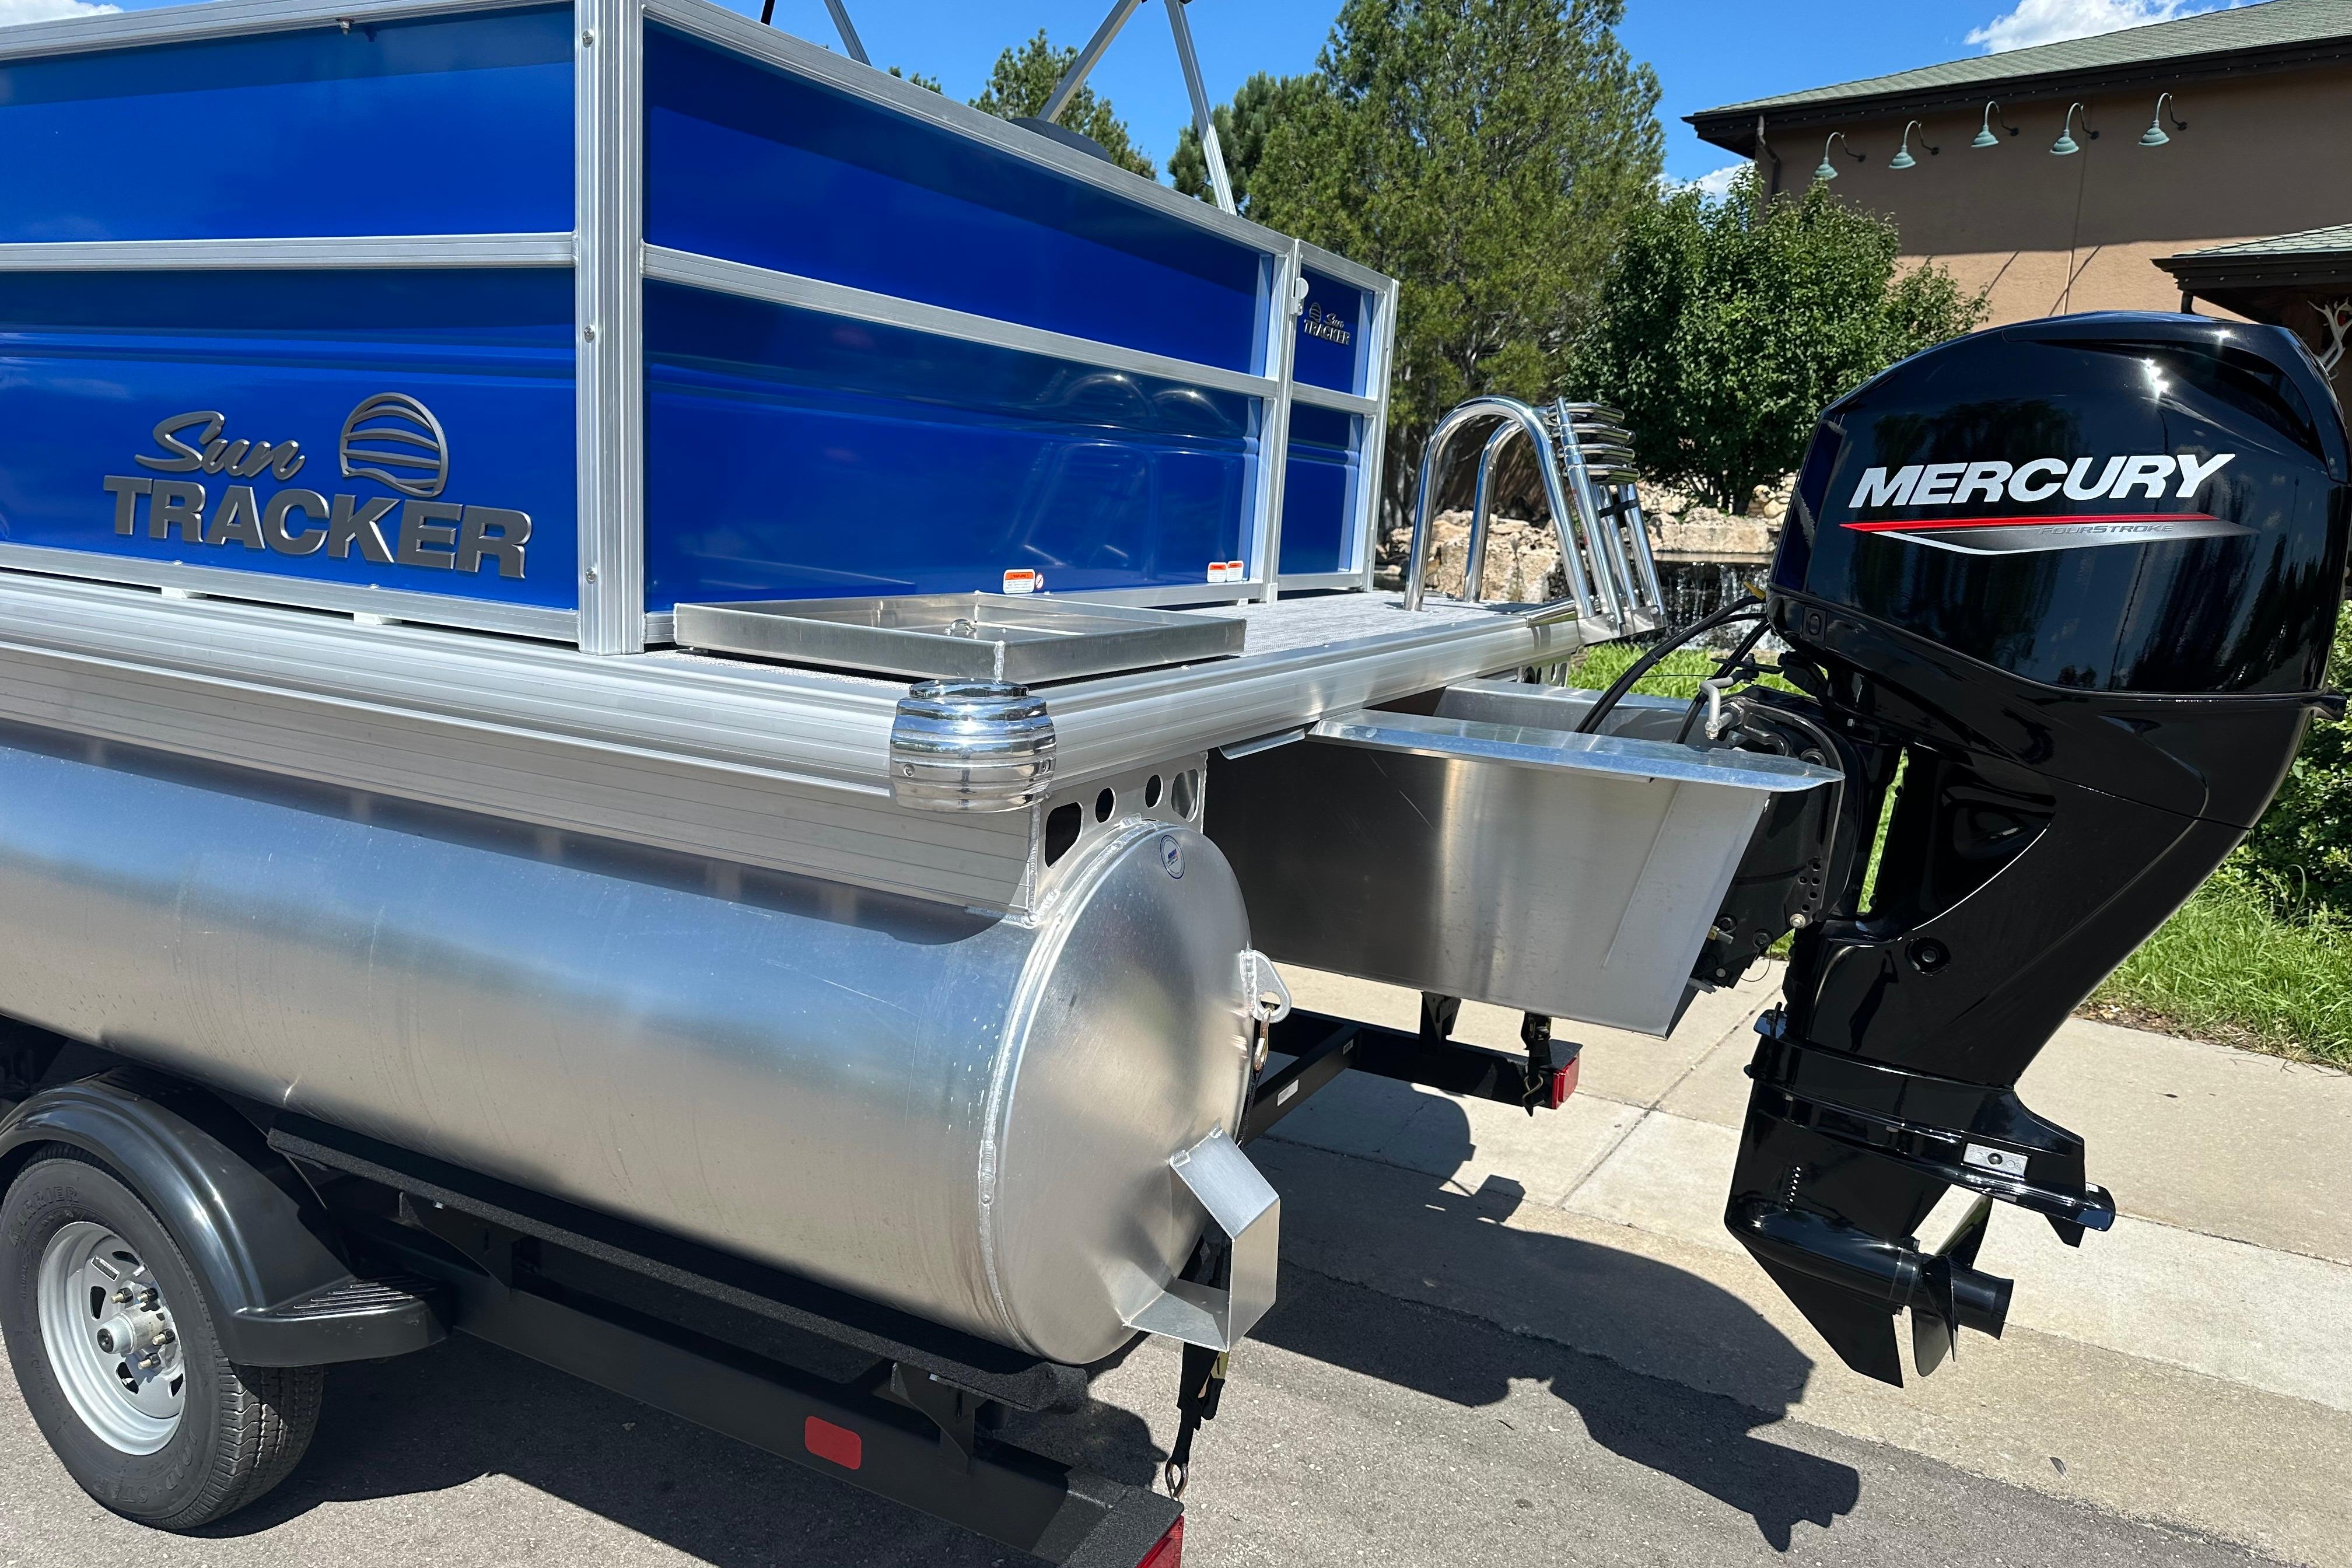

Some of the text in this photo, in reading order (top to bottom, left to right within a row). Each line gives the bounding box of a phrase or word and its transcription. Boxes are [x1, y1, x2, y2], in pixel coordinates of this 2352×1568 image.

[1304, 319, 1350, 345] TRACKER
[1324, 313, 1344, 328] Sun
[135, 411, 305, 480] Sun
[1849, 454, 2235, 508] MERCURY
[104, 475, 532, 579] TRACKER
